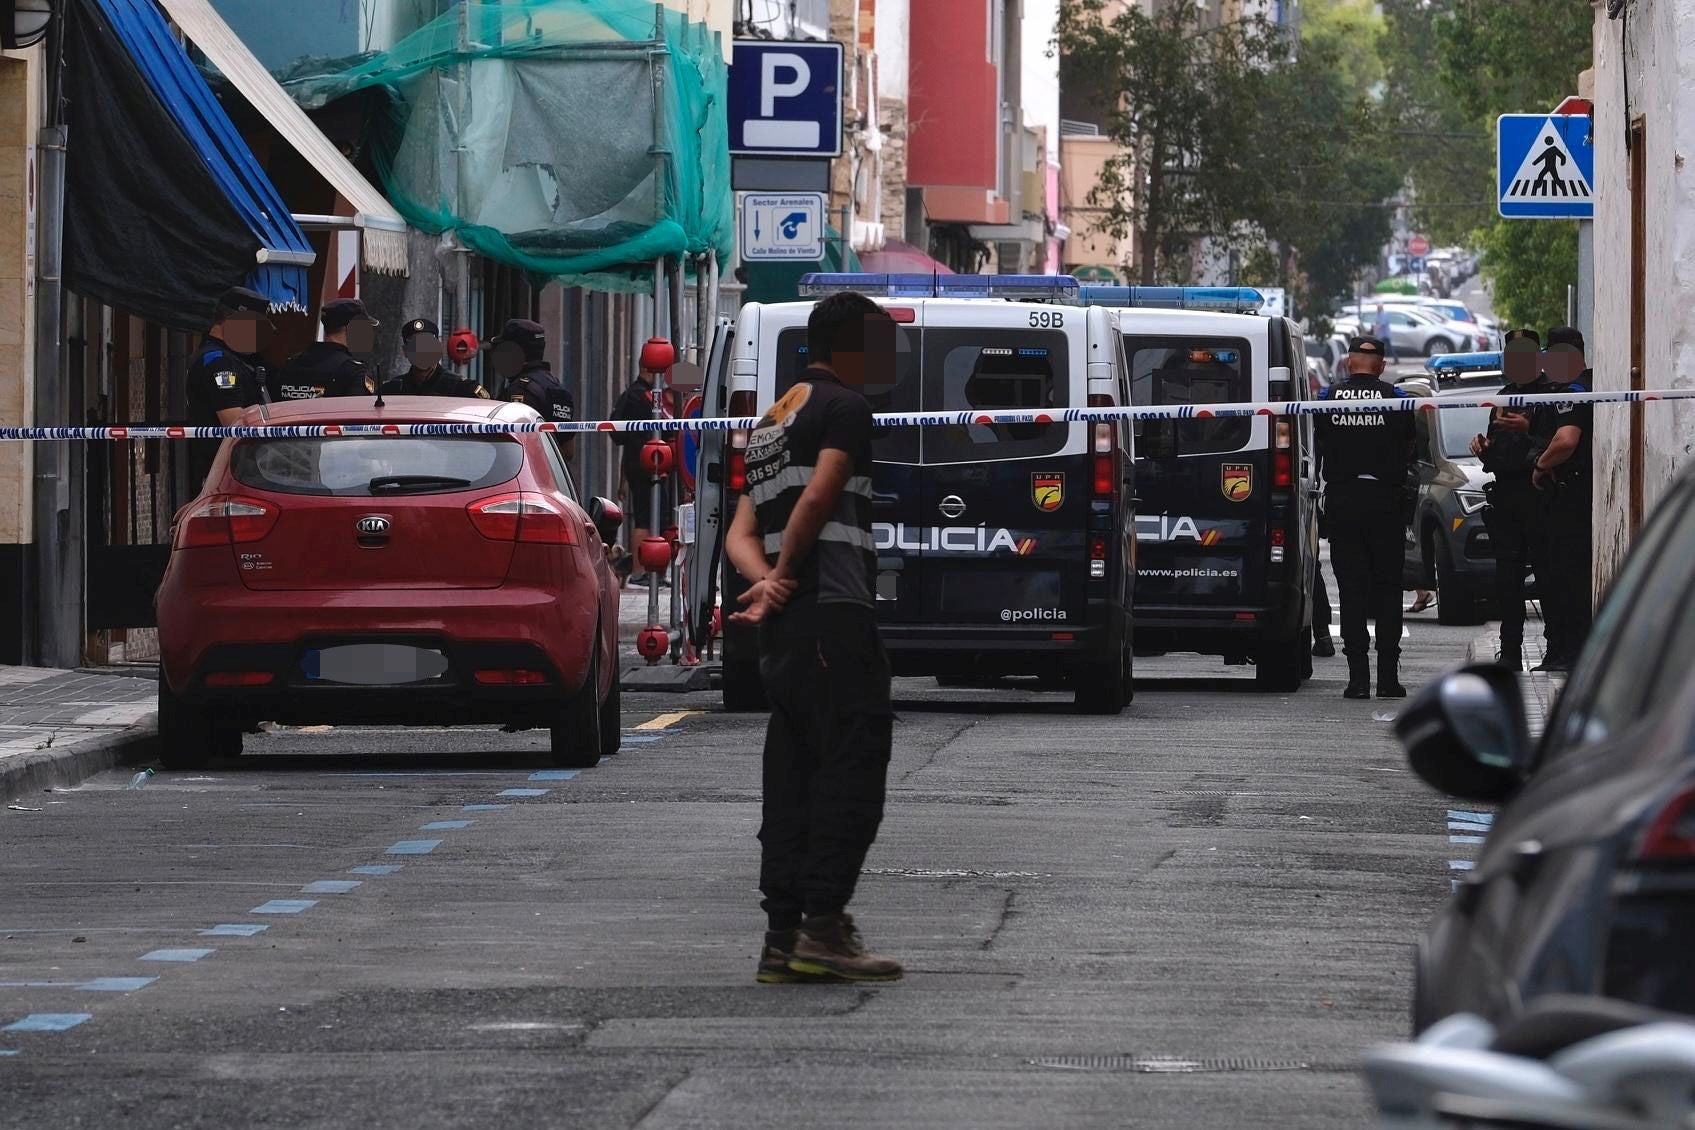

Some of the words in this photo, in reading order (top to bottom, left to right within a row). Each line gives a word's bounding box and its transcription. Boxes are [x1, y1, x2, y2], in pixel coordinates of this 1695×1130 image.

[760, 52, 811, 117] P
[752, 198, 778, 206] Sector
[780, 198, 814, 206] Arenales
[752, 247, 767, 255] Calle
[1028, 311, 1064, 328] 59B
[281, 385, 316, 393] POLICIA
[1335, 389, 1383, 399] POLICIA
[1331, 414, 1385, 426] CANARIA
[362, 520, 385, 531] KIA
[872, 521, 1018, 551] OLICÍA
[1138, 568, 1238, 578] www.policia.es
[1000, 608, 1067, 622] @policia
